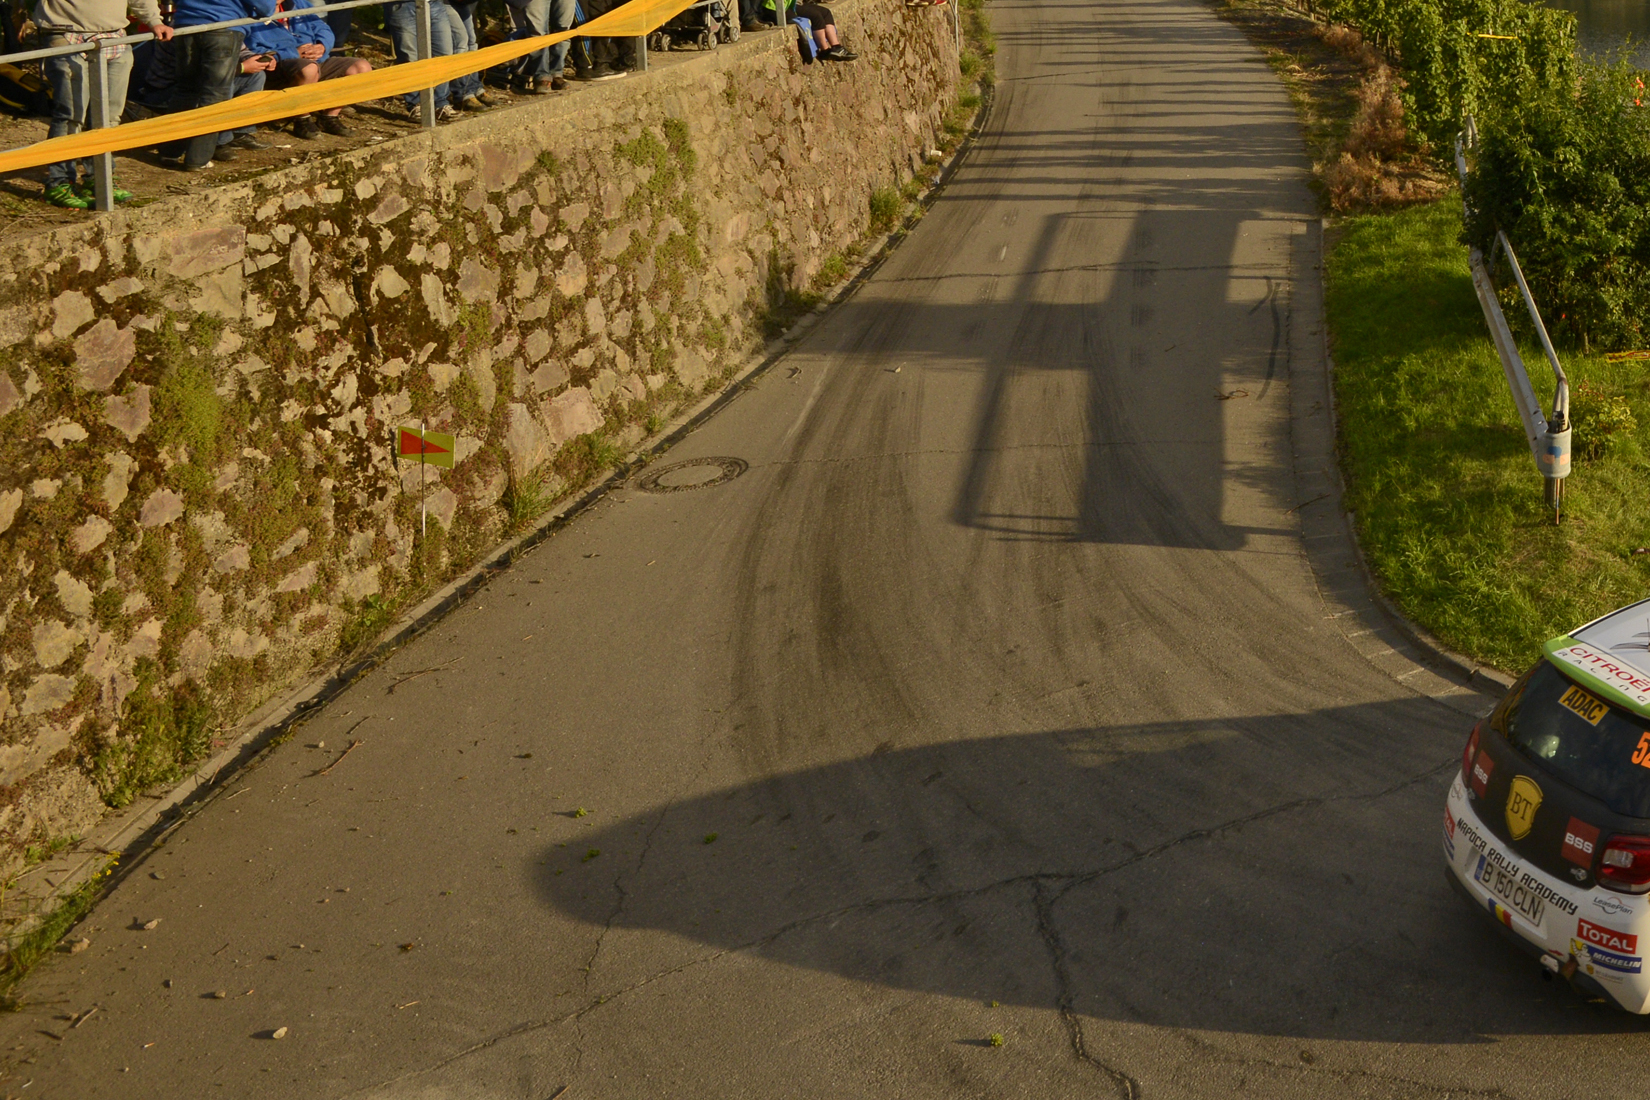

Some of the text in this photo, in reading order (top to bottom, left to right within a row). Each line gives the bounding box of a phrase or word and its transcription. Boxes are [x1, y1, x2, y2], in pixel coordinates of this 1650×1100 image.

[1562, 688, 1603, 722] ADAC
[1474, 764, 1488, 785] BSS
[1510, 792, 1533, 821] BT
[1564, 832, 1593, 854] BSS
[1456, 817, 1578, 915] NAPOCA RALLY ACADEMY
[1482, 863, 1540, 920] B 150 CLN
[1594, 897, 1633, 915] LeasePlan
[1580, 922, 1633, 951] TOTAL
[1592, 952, 1642, 968] MICHELIN
